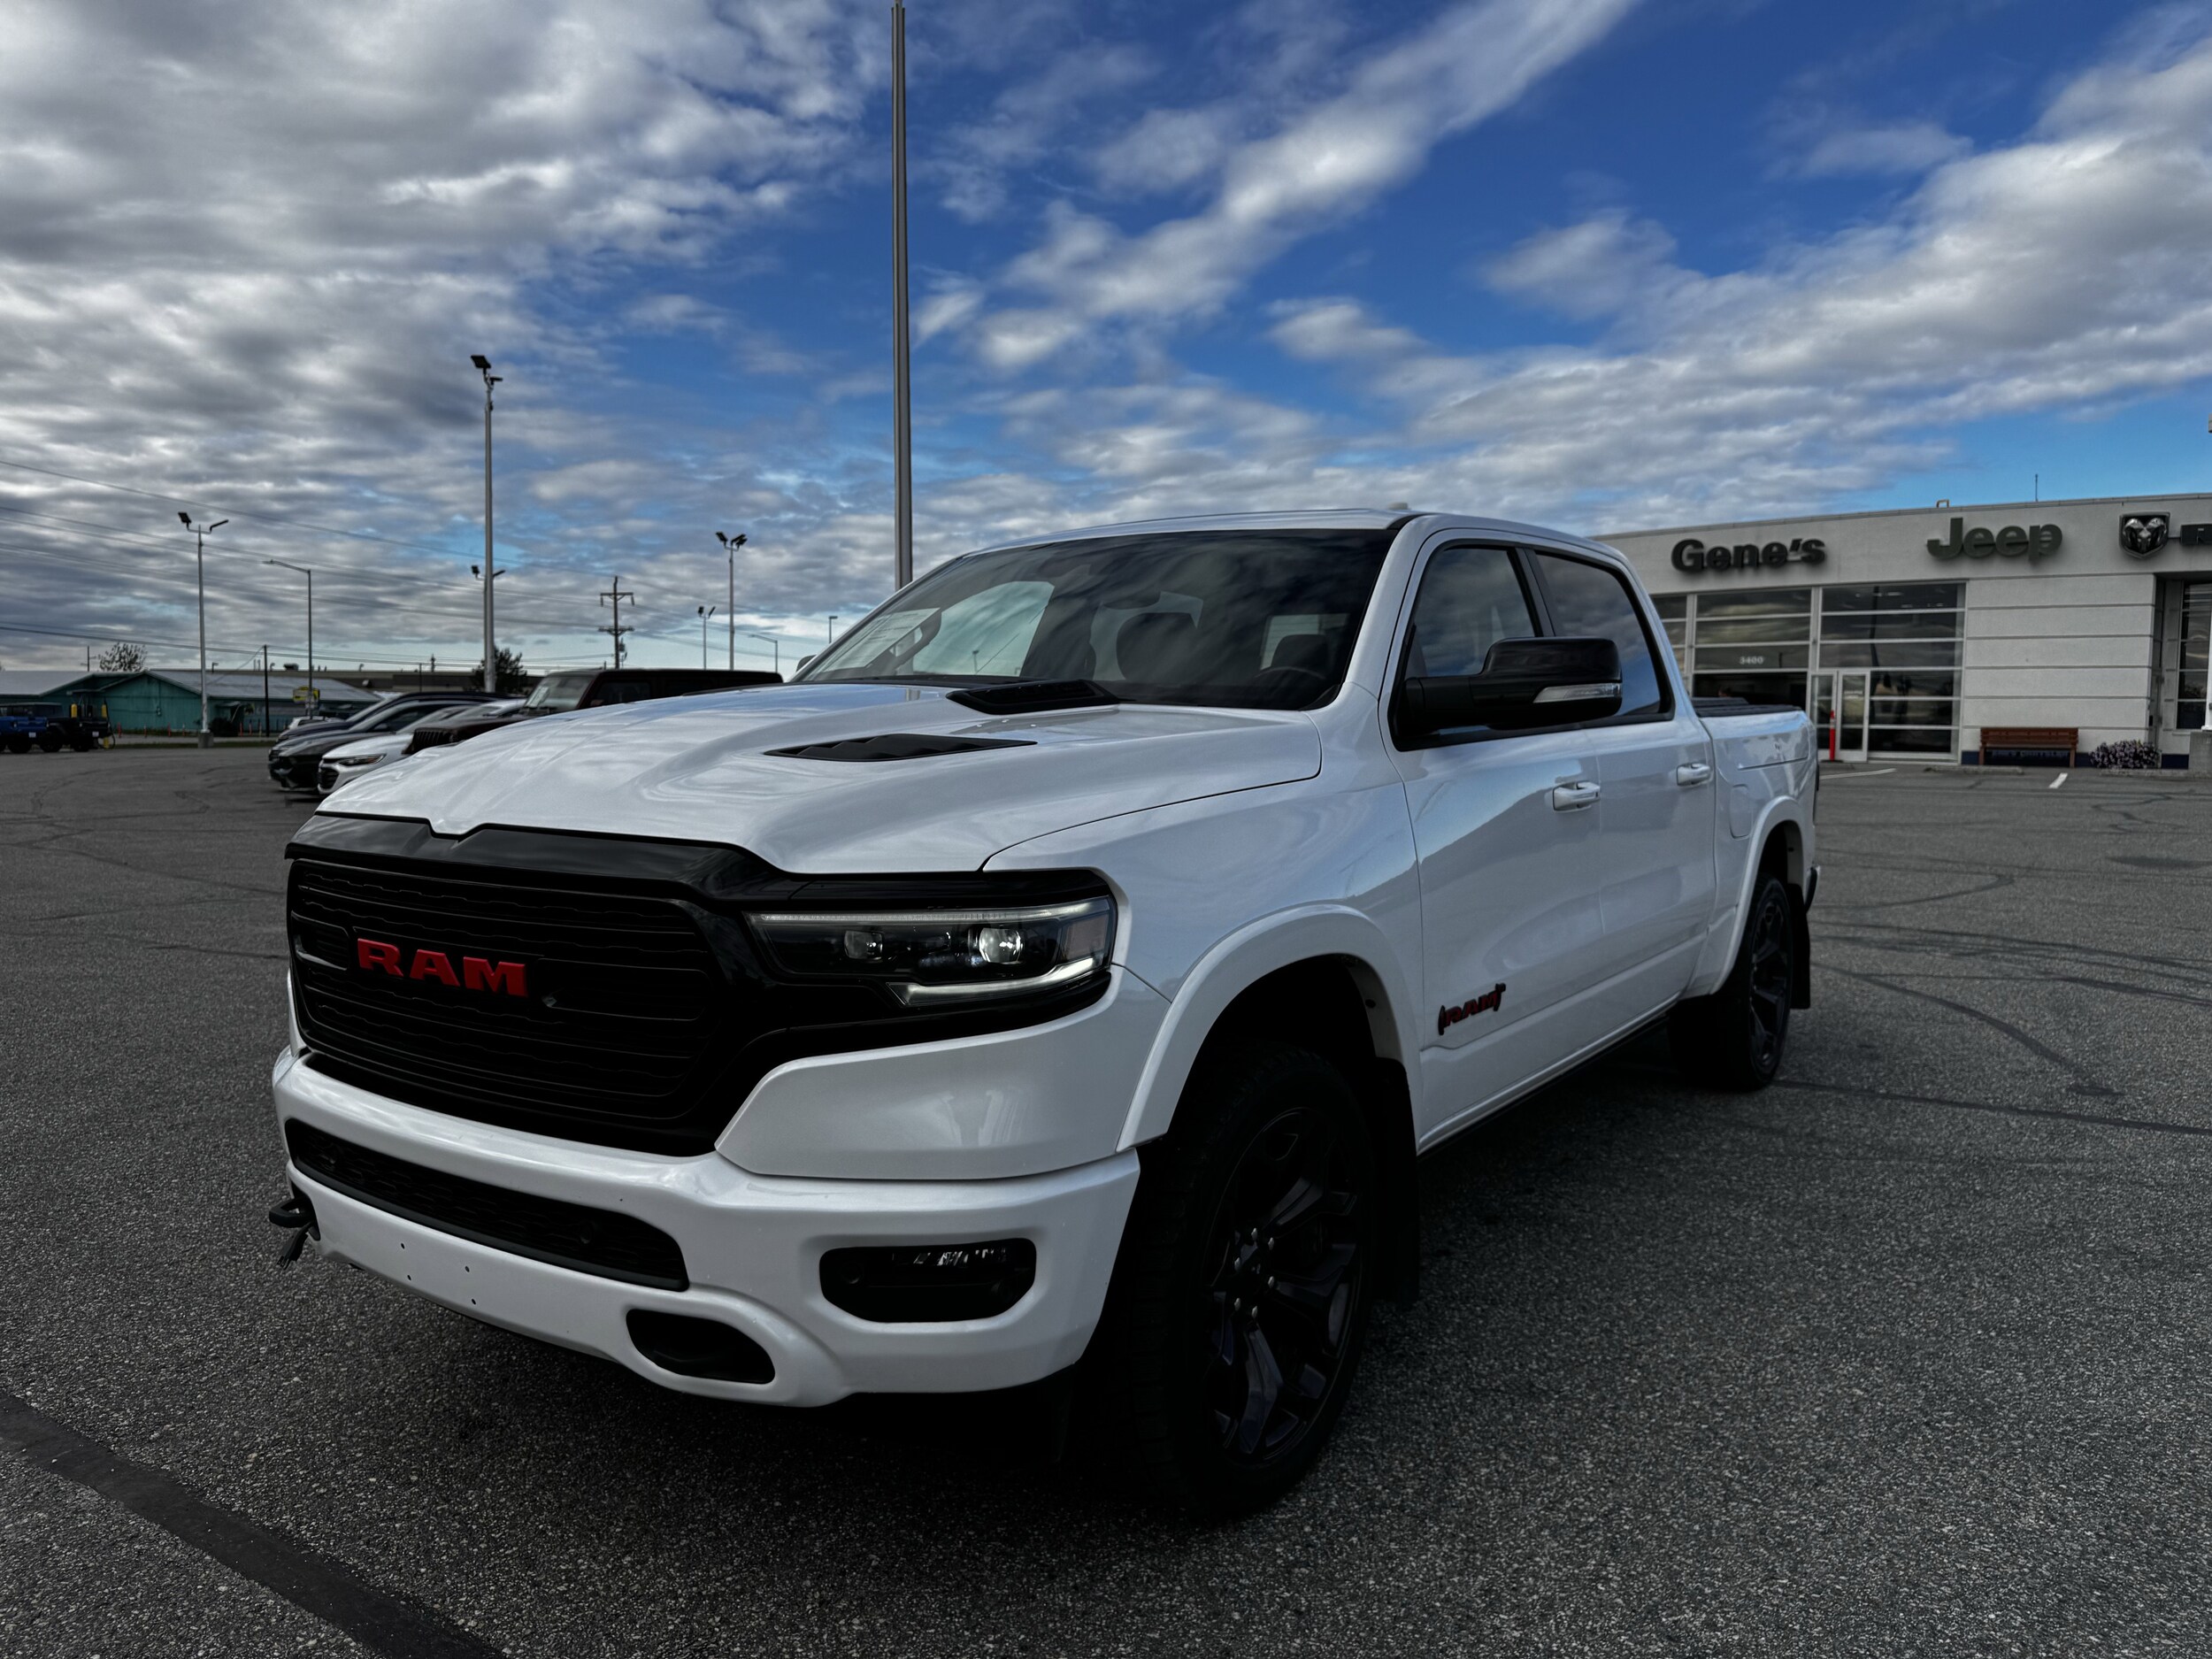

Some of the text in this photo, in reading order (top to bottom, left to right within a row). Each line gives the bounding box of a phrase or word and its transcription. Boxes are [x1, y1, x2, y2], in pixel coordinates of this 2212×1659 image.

[1671, 539, 1825, 572] Gene's
[1927, 518, 2062, 562] Jeep
[357, 938, 528, 997] RAM
[1441, 987, 1502, 1029] RAM
